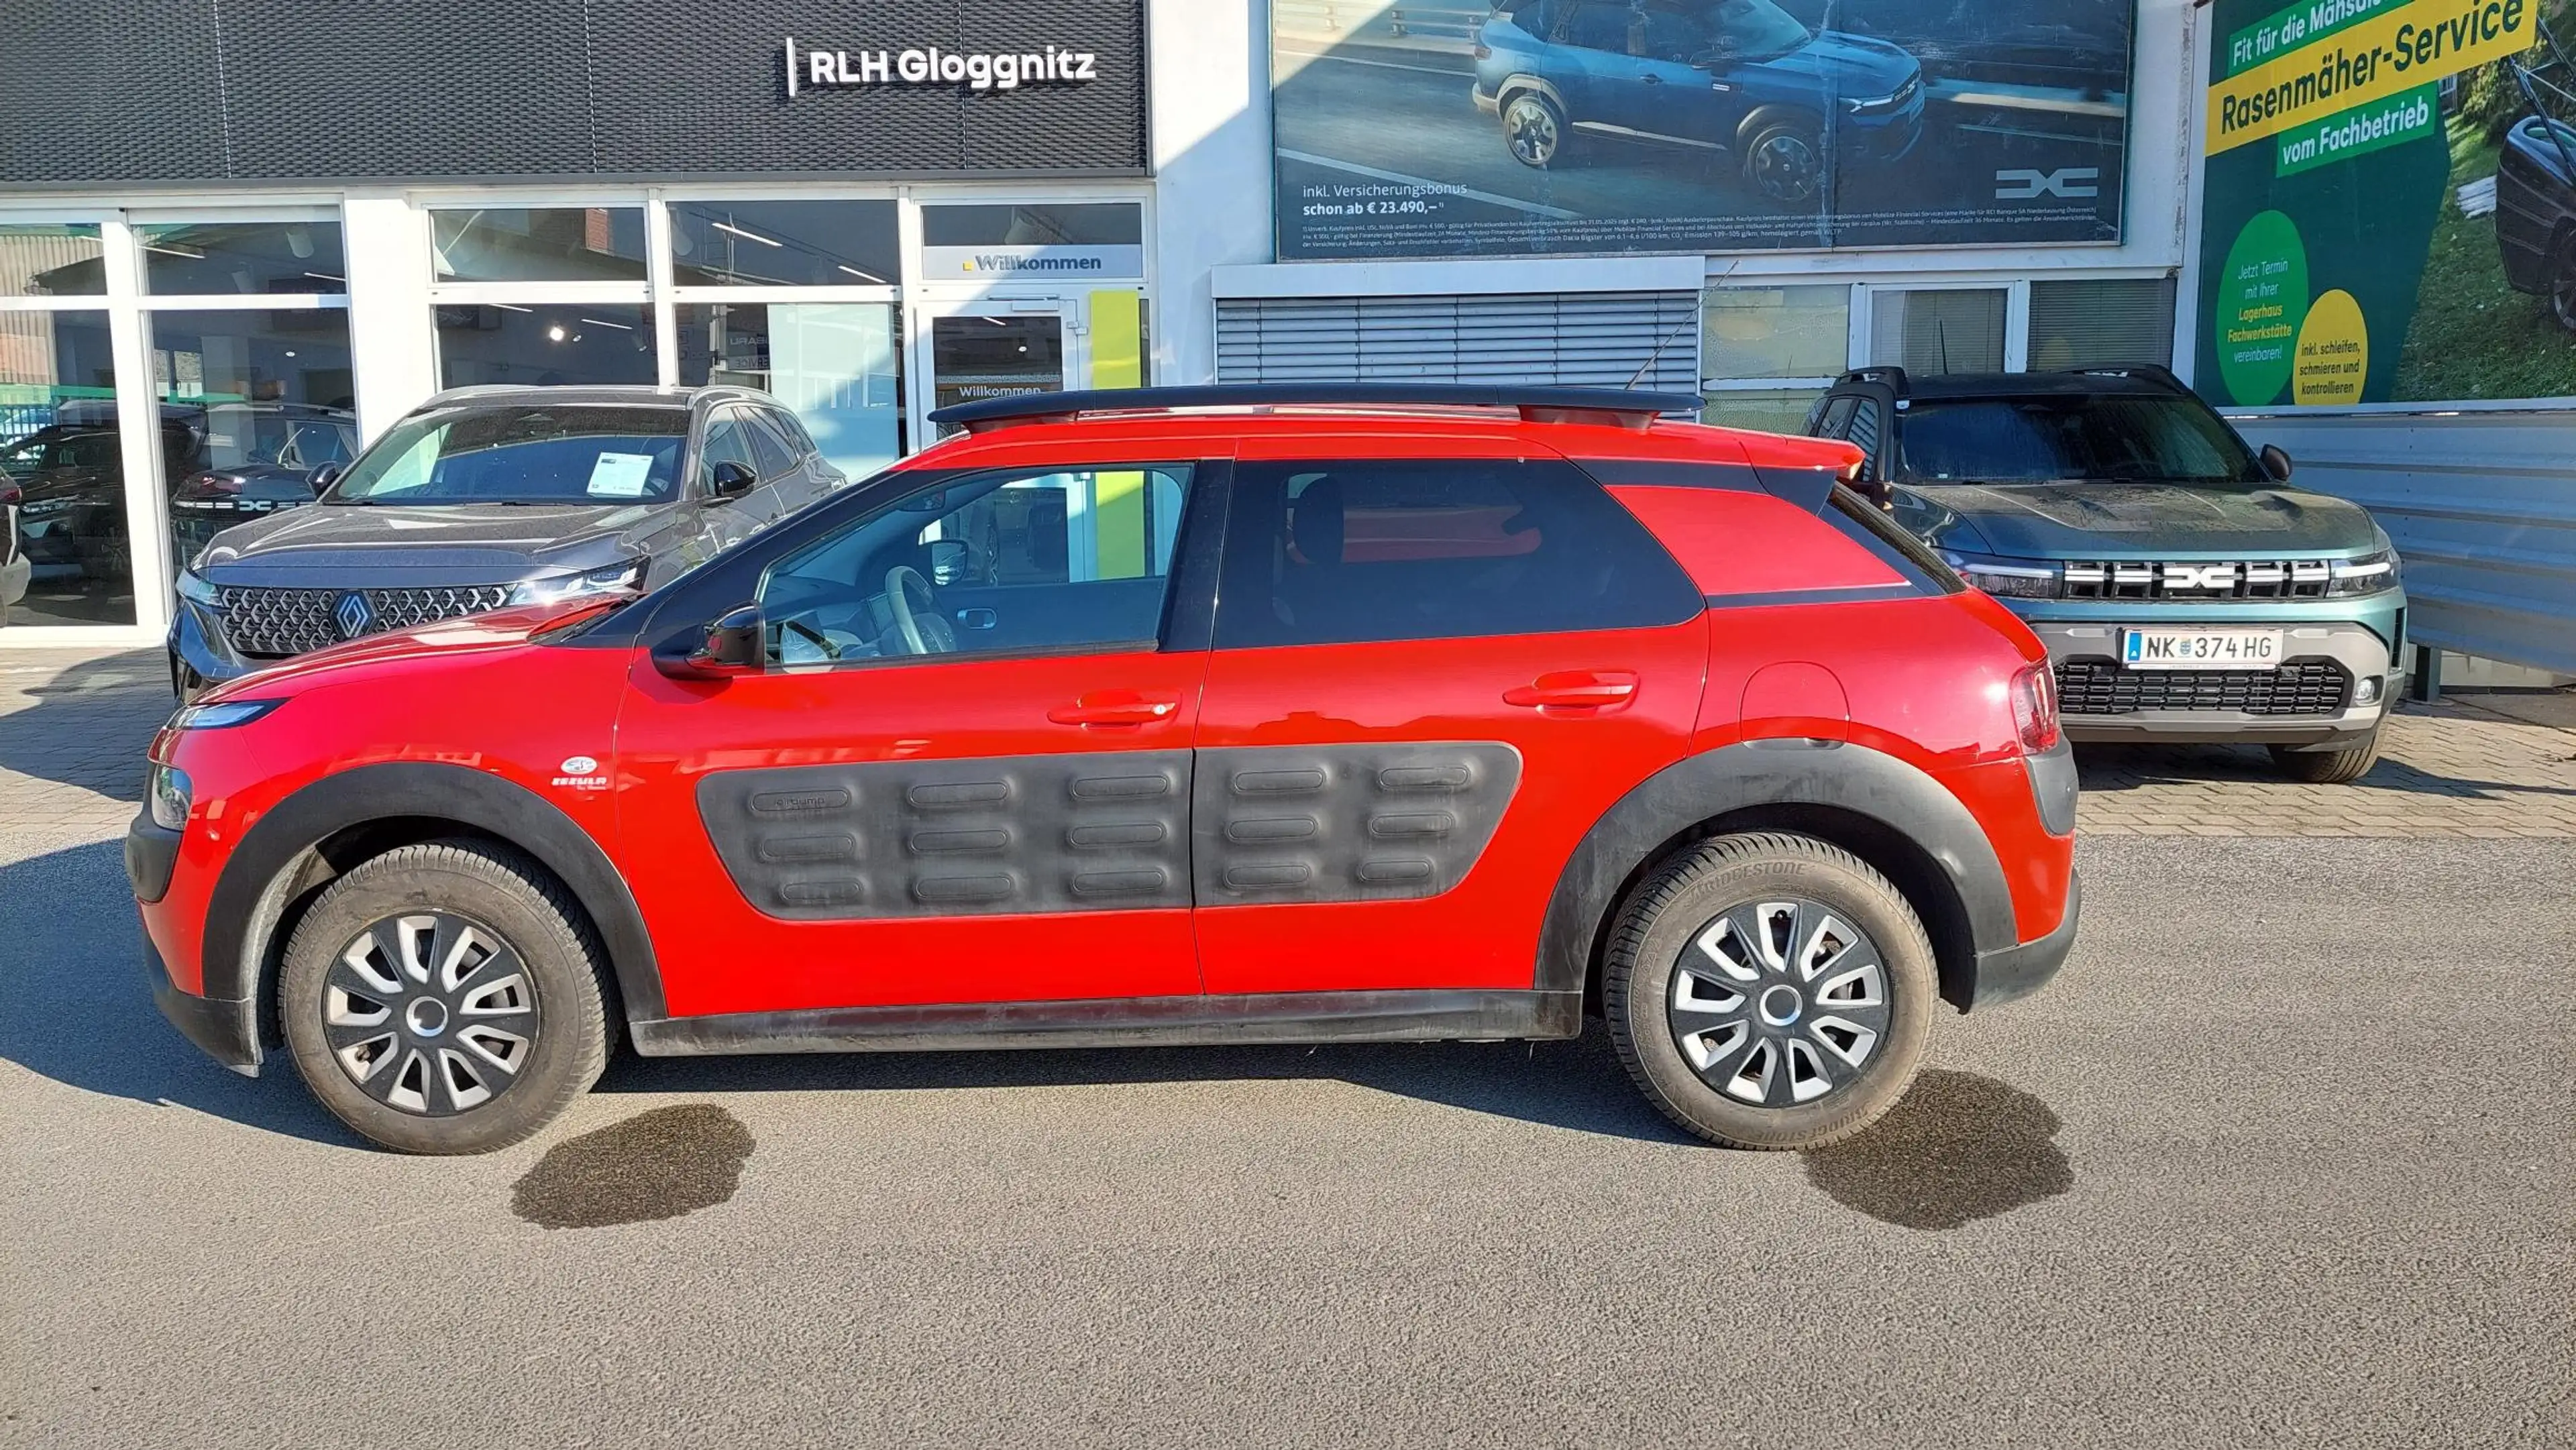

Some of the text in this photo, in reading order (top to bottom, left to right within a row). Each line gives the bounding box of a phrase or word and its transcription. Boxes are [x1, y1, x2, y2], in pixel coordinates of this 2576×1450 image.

[2233, 0, 2381, 66] Fit für die Mähsa
[810, 46, 1096, 89] RLH Gloggnitz
[2221, 0, 2523, 135] Rasenmäher-Service
[2283, 96, 2428, 165] vom Fachbetrieb
[1303, 182, 1468, 198] inkl. Versicherungsbonus
[1303, 203, 1342, 216] schon
[1347, 203, 1364, 215] ab
[1366, 202, 1377, 214] €
[975, 255, 1102, 270] Willkommen
[2238, 258, 2288, 280] Jetzt Termin
[2245, 282, 2279, 300] mit Ihrer
[2239, 303, 2283, 323] Lagerhaus
[2227, 323, 2292, 343] Fachwerkstätte
[2234, 345, 2282, 363] vereinbaren!
[2301, 340, 2361, 356] inkl. schleifen,
[2299, 359, 2360, 376] schmieren und
[959, 384, 1041, 398] Willkommen
[2301, 380, 2354, 395] kontrollieren
[2147, 636, 2272, 658] NK 374 HG
